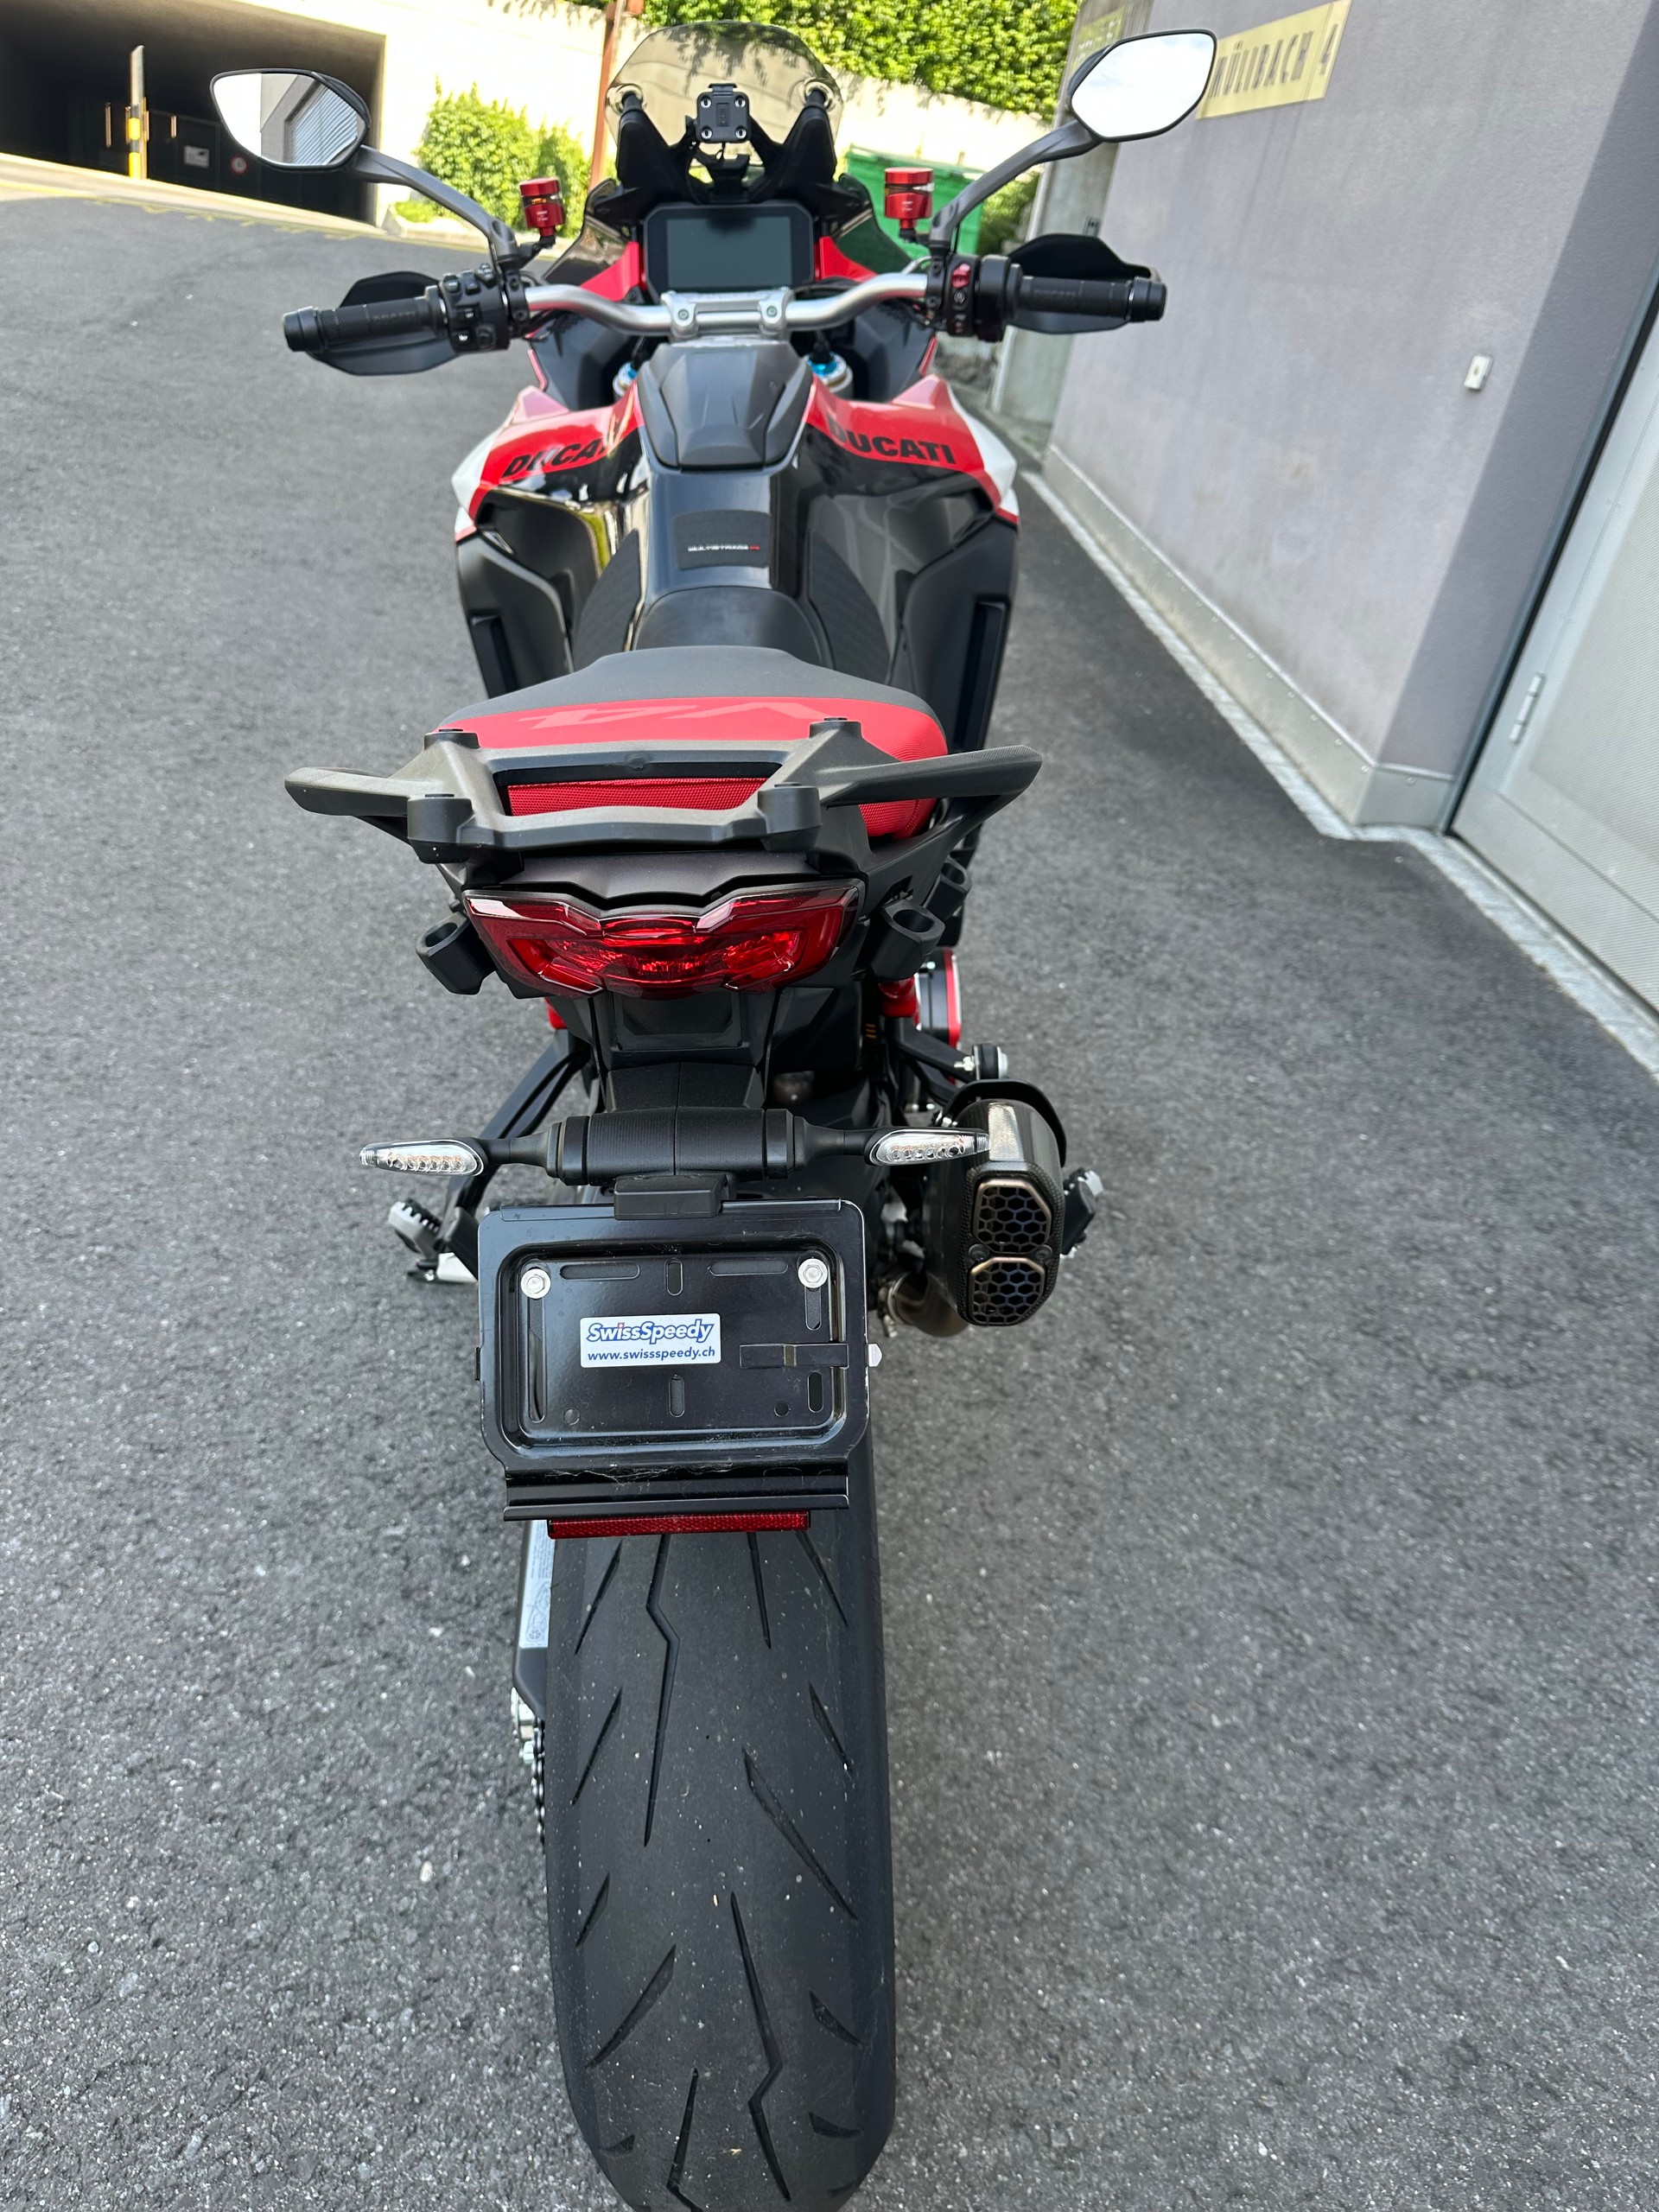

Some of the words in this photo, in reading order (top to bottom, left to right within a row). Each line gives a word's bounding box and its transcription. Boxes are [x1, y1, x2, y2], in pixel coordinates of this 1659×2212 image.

[1318, 23, 1339, 76] 4
[826, 413, 957, 464] DUCATI
[587, 1319, 715, 1344] SwissSpeedy
[588, 1346, 715, 1361] www.swissspeedy.ch
